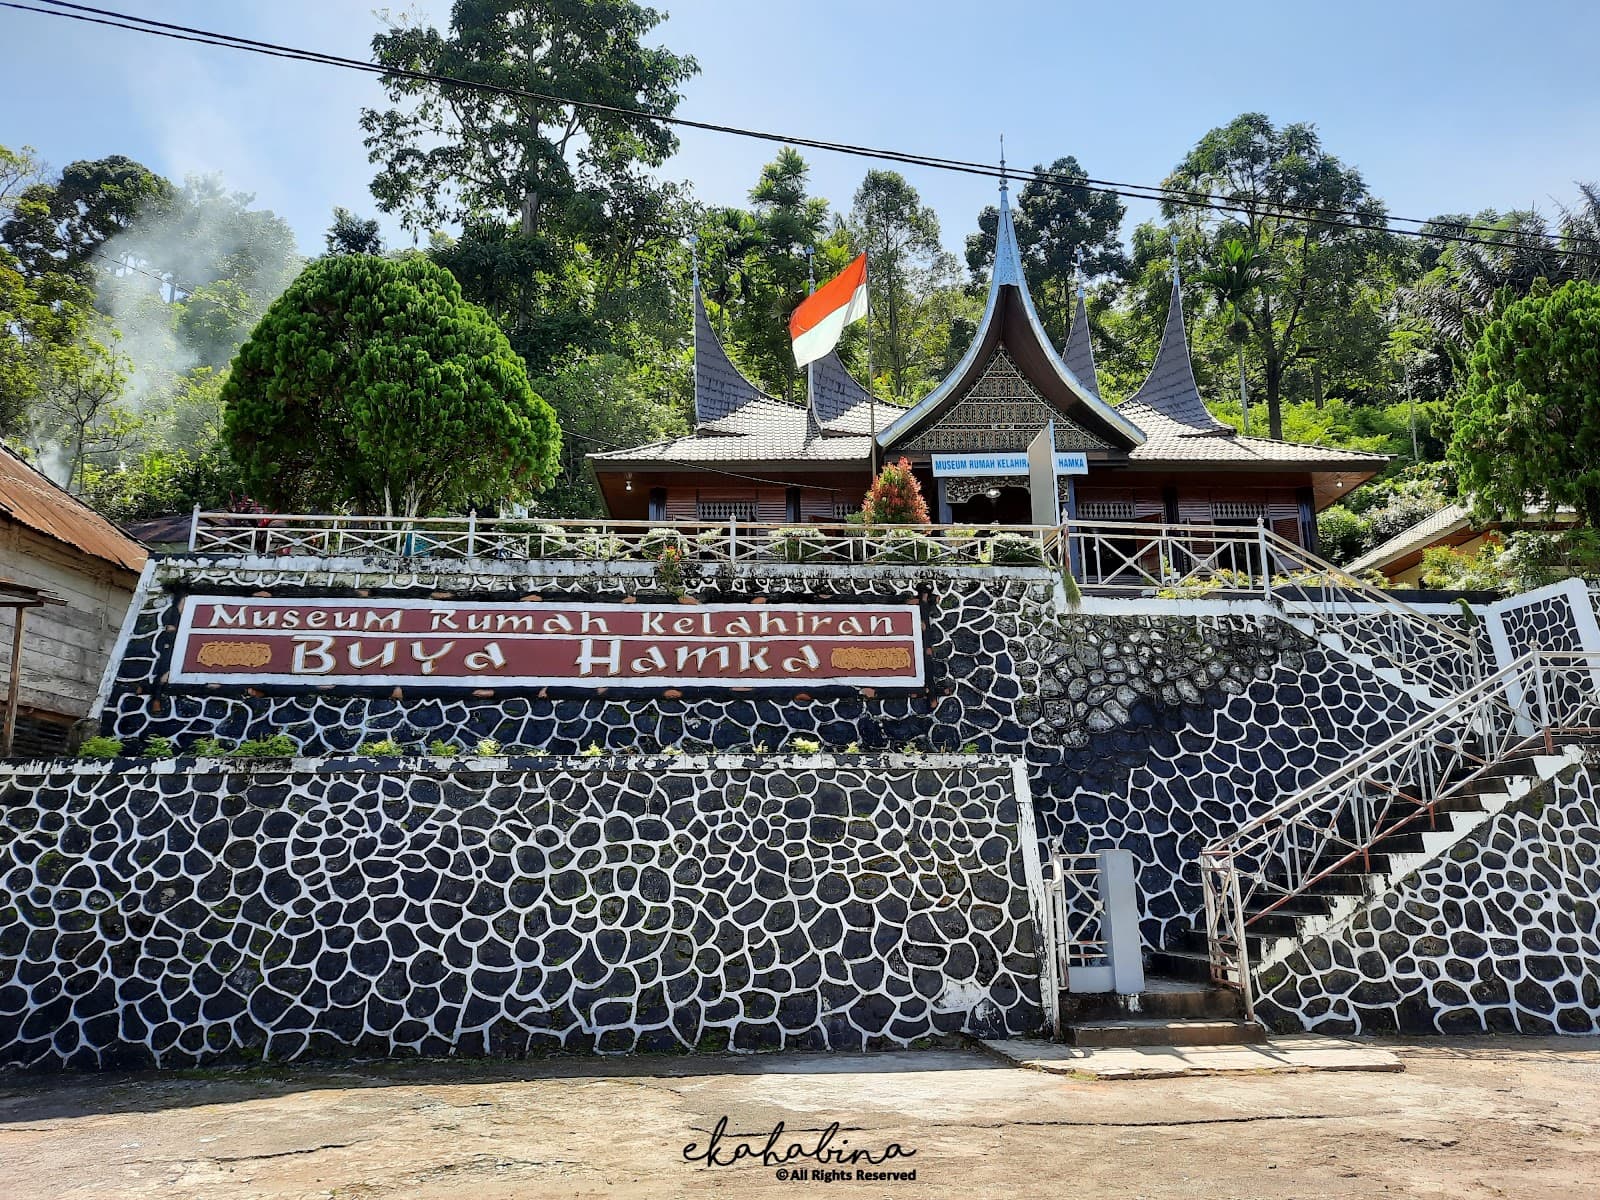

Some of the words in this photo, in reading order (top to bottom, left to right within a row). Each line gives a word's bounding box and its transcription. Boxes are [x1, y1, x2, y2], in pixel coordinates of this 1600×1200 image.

[935, 460, 967, 470] MUSEUM
[969, 459, 995, 469] RUMAH
[997, 458, 1030, 468] KELAHIR
[1058, 458, 1084, 467] HAMKA
[207, 605, 403, 630] Museum
[429, 609, 609, 634] Rumah
[641, 611, 895, 636] Kelahiran
[290, 635, 508, 675] Buya
[574, 638, 820, 677] Hamka
